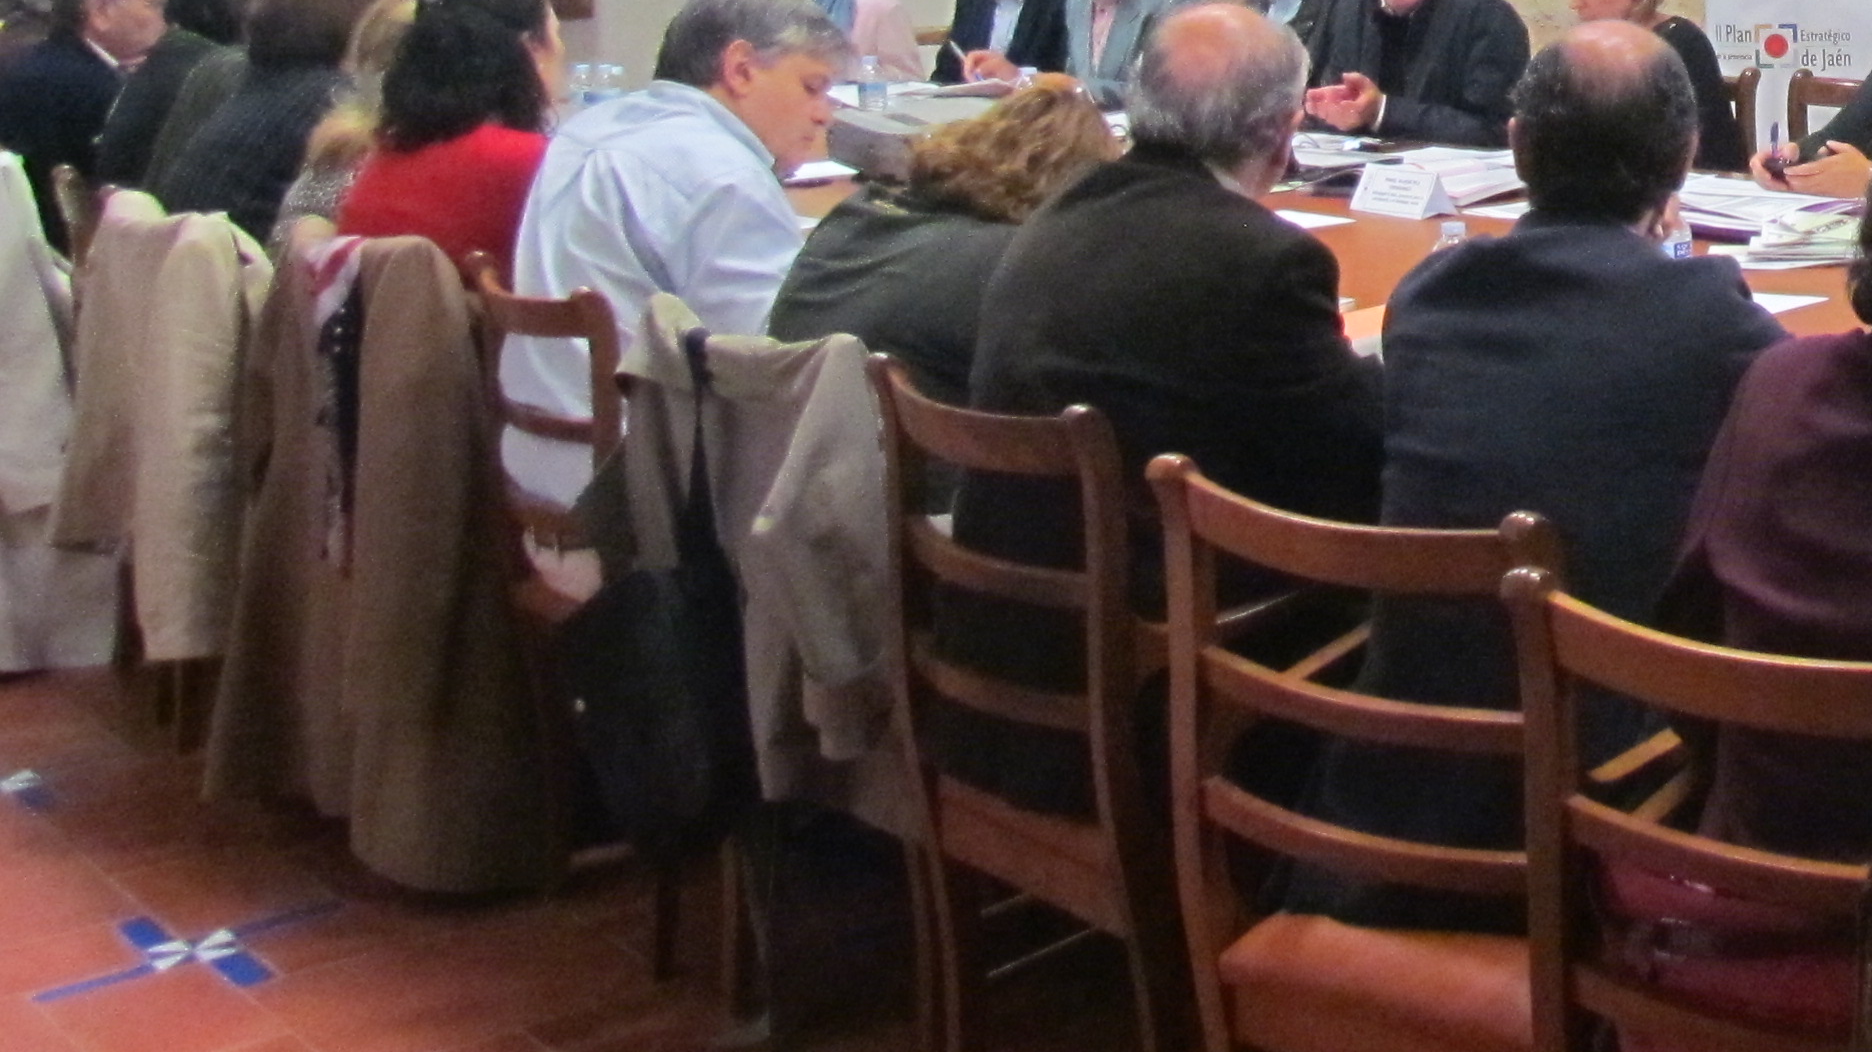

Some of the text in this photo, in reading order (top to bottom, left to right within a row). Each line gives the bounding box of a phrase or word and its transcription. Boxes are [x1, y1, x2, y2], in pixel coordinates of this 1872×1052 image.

[1726, 25, 1752, 43] Plan
[1800, 28, 1850, 45] Estratégico
[1802, 49, 1818, 67] de
[1821, 48, 1851, 71] Jaén
